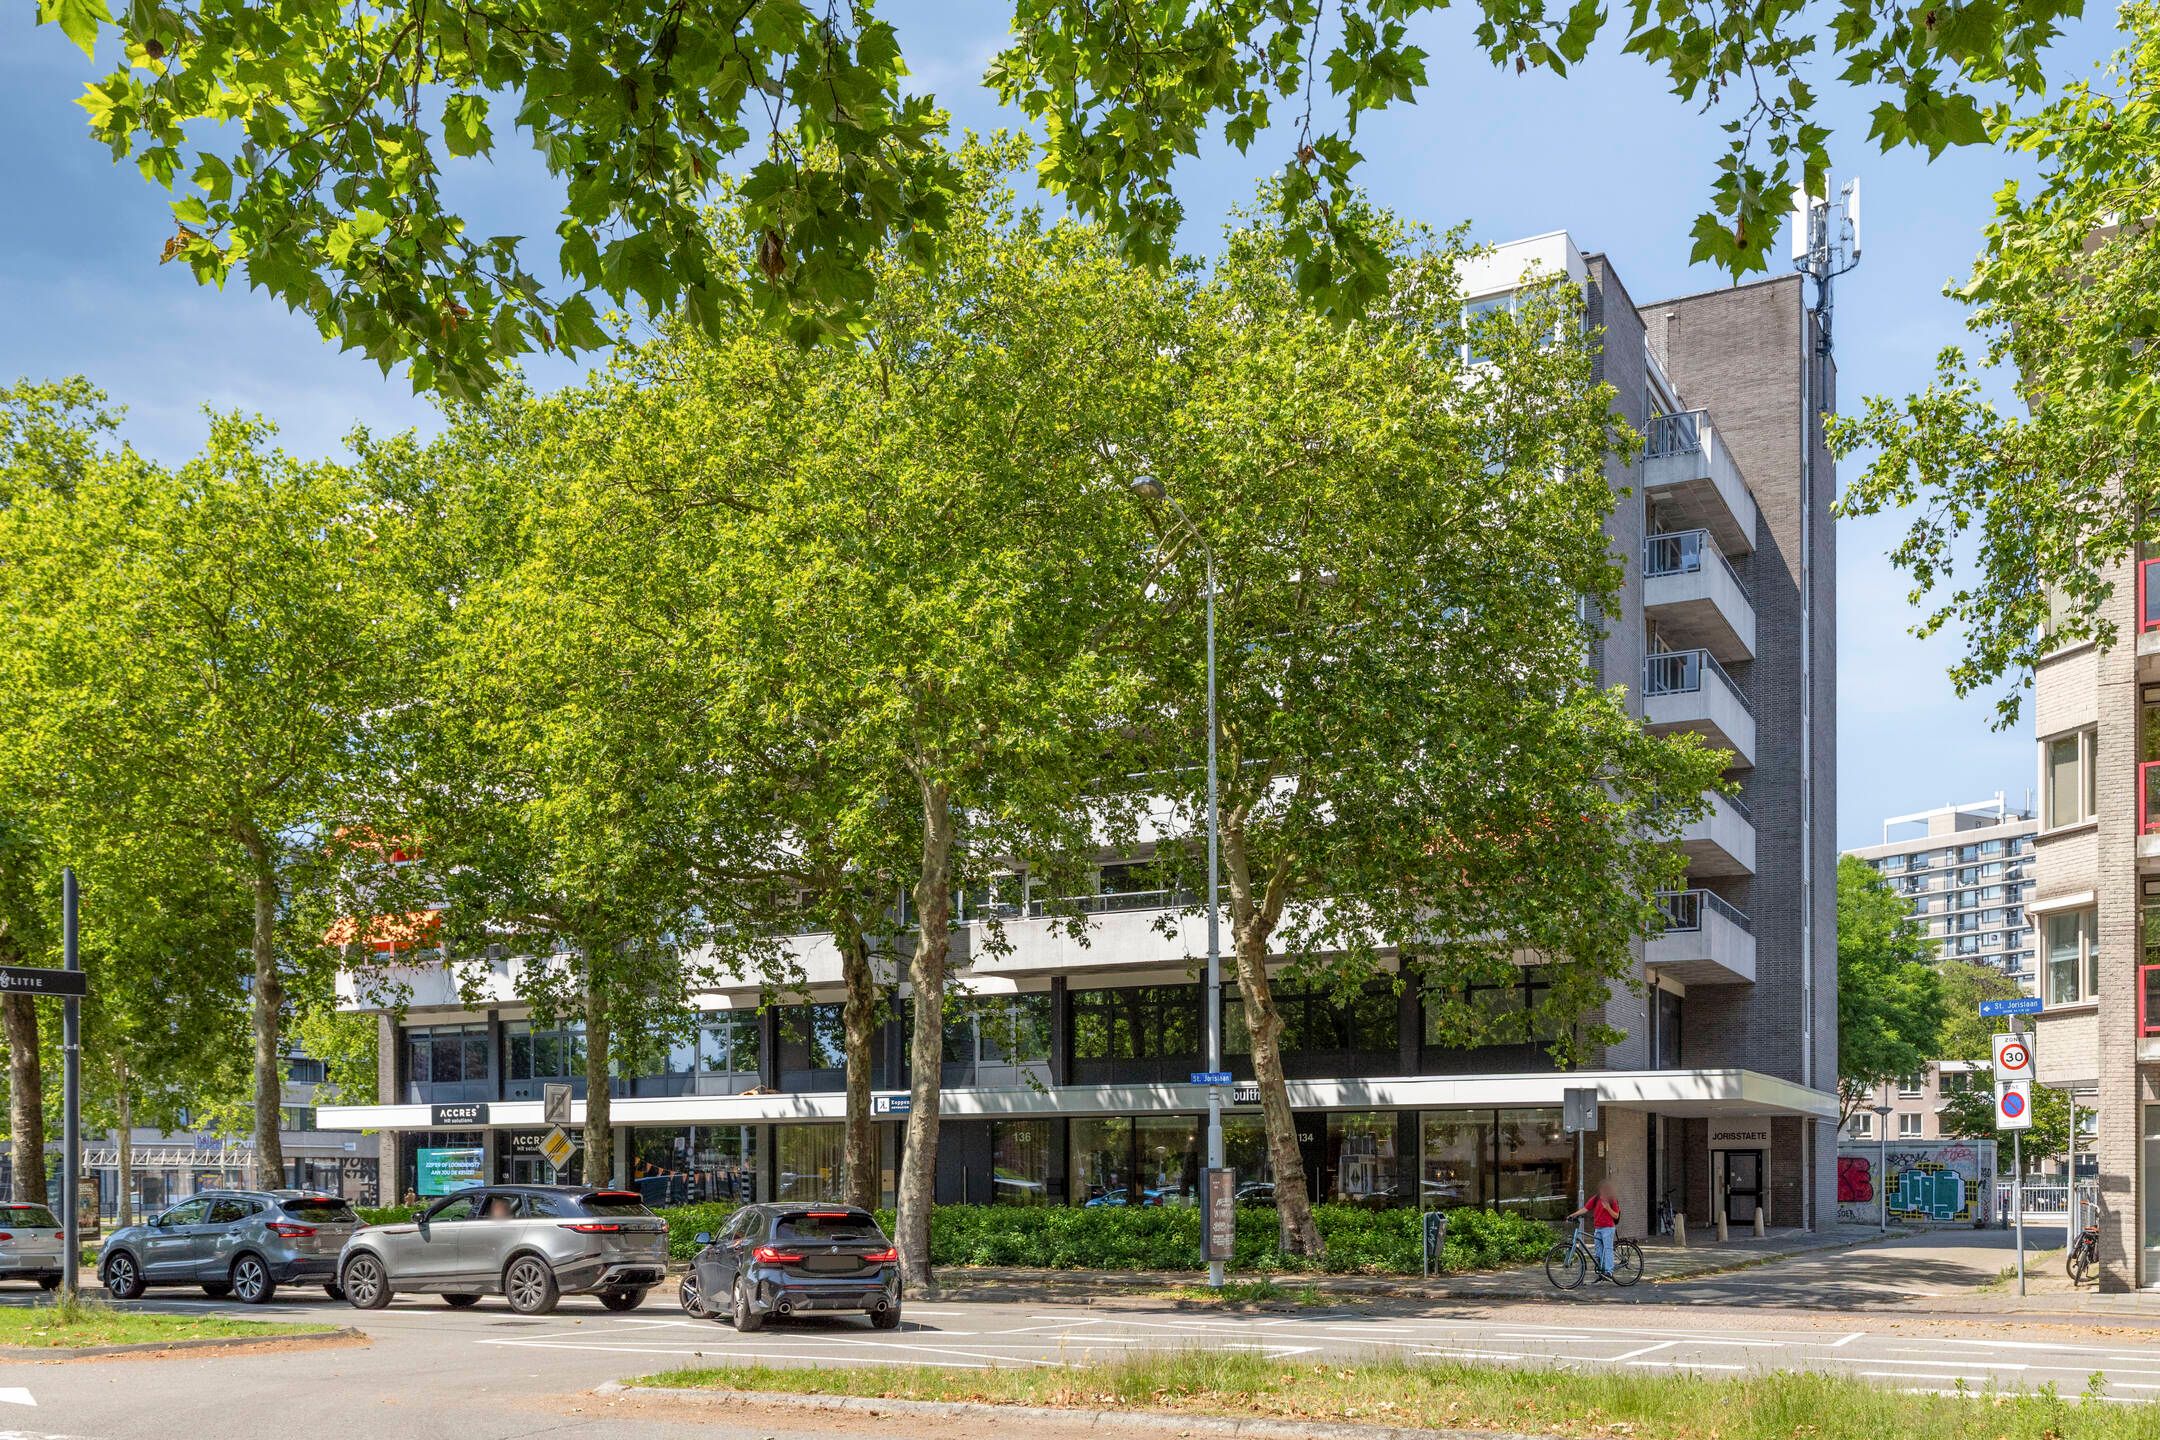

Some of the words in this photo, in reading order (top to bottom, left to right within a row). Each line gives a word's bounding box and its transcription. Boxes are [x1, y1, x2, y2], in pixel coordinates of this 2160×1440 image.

[2008, 1000, 2038, 1009] Jorislaan
[2005, 1052, 2024, 1063] 30
[1233, 1088, 1261, 1102] bulth
[439, 1108, 477, 1118] ACCRES
[1013, 1131, 1031, 1142] 136
[1298, 1133, 1313, 1142] 134
[1712, 1131, 1767, 1140] JORISSTAETE
